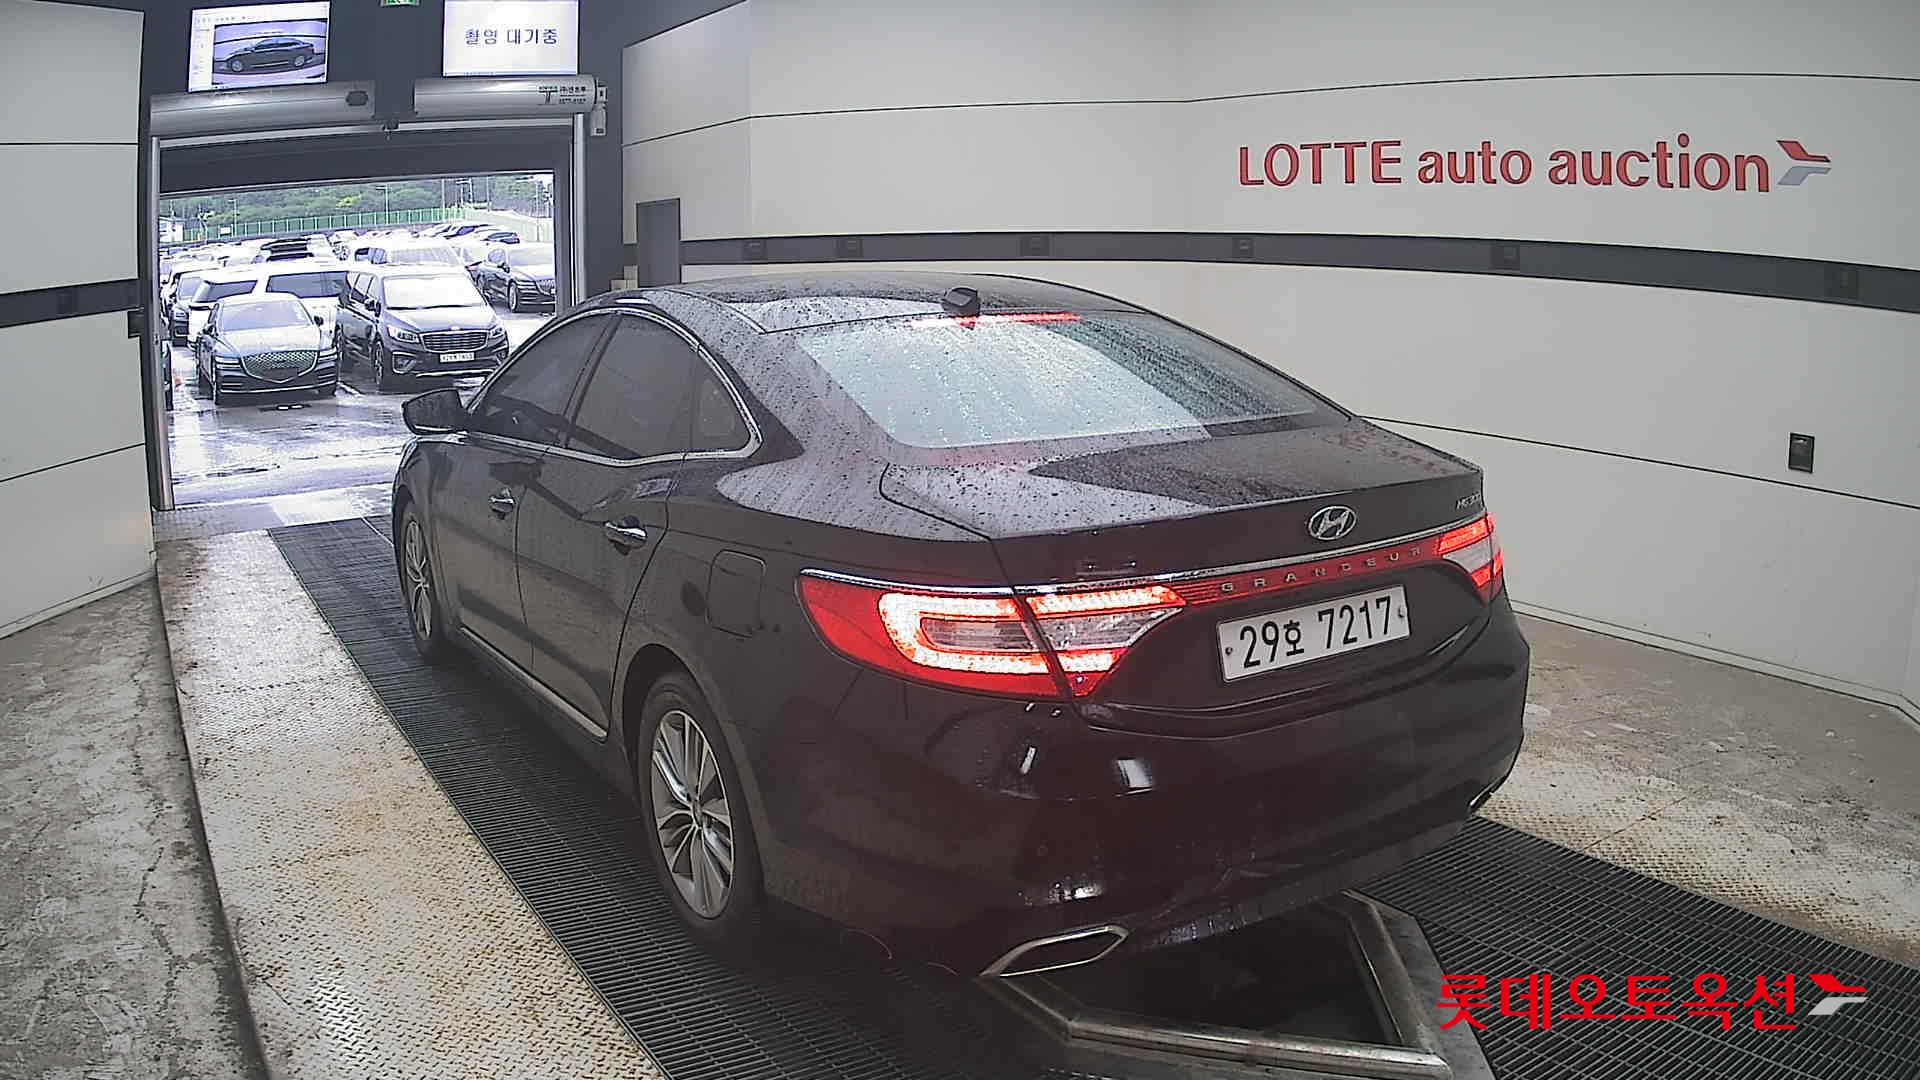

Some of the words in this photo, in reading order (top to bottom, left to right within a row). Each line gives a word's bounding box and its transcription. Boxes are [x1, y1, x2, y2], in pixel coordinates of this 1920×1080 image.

[507, 27, 558, 45] 대기중
[1239, 140, 1402, 187] LOTTE
[1417, 141, 1532, 186] auto
[1549, 133, 1769, 192] auction
[1222, 548, 1421, 592] GRANDEUR
[1240, 620, 1305, 669] 29호
[1318, 596, 1391, 649] 7217
